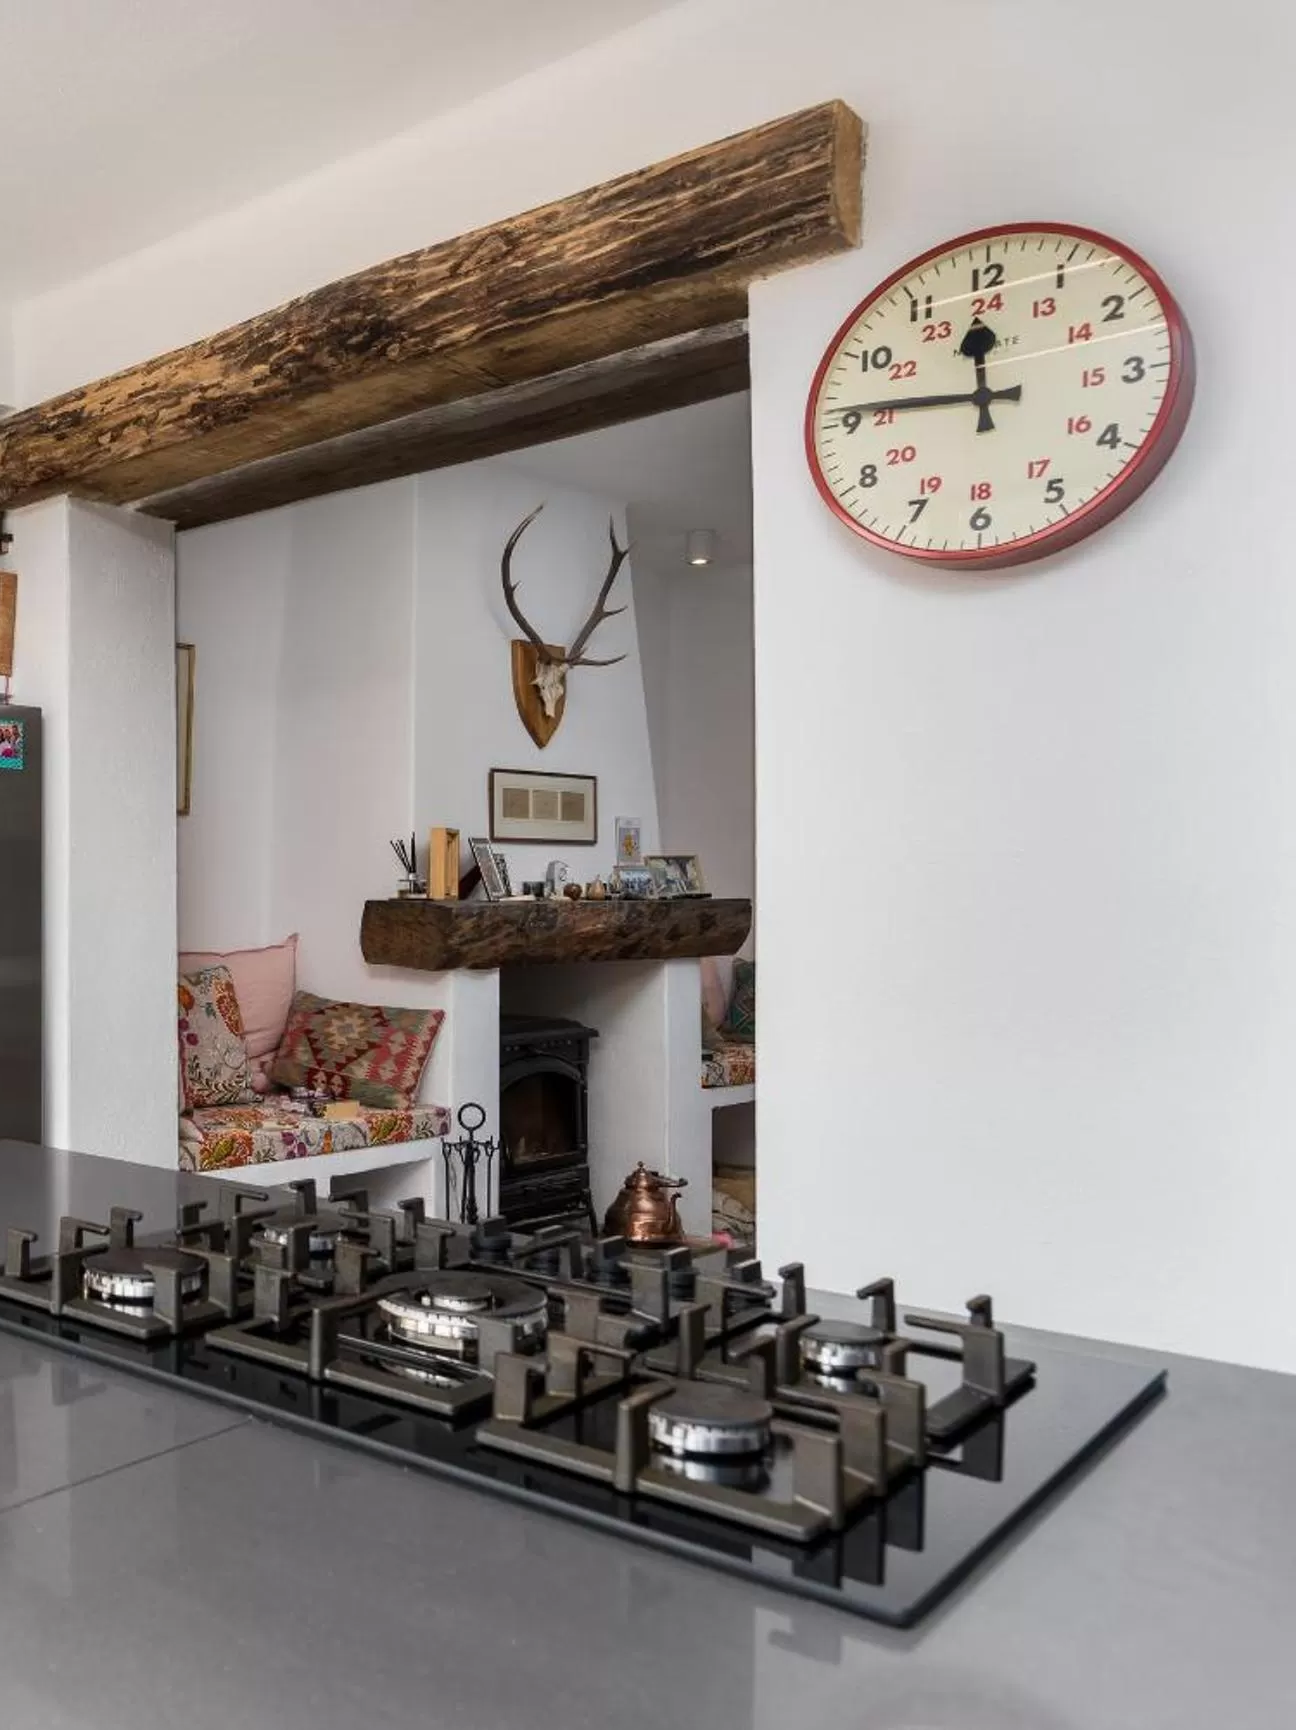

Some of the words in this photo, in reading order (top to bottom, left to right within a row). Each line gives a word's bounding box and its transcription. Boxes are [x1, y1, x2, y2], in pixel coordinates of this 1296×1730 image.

[972, 264, 1005, 292] 12
[1056, 264, 1064, 289] 1
[910, 295, 932, 322] 11
[971, 293, 1004, 317] 24
[1033, 298, 1056, 318] 13
[1102, 295, 1124, 322] 2
[922, 321, 951, 342] 23
[1068, 323, 1092, 343] 14
[862, 346, 893, 372] 10
[888, 361, 916, 380] 22
[1122, 357, 1144, 383] 3
[1083, 368, 1104, 387] 15
[841, 411, 862, 434] 9
[873, 410, 895, 426] 21
[1068, 416, 1091, 434] 16
[1097, 424, 1121, 449] 4
[887, 446, 916, 465] 20
[859, 465, 877, 488] 8
[1028, 460, 1050, 478] 17
[921, 477, 941, 494] 19
[971, 483, 991, 500] 18
[1044, 478, 1065, 504] 5
[909, 499, 928, 522] 7
[970, 507, 991, 530] 6
